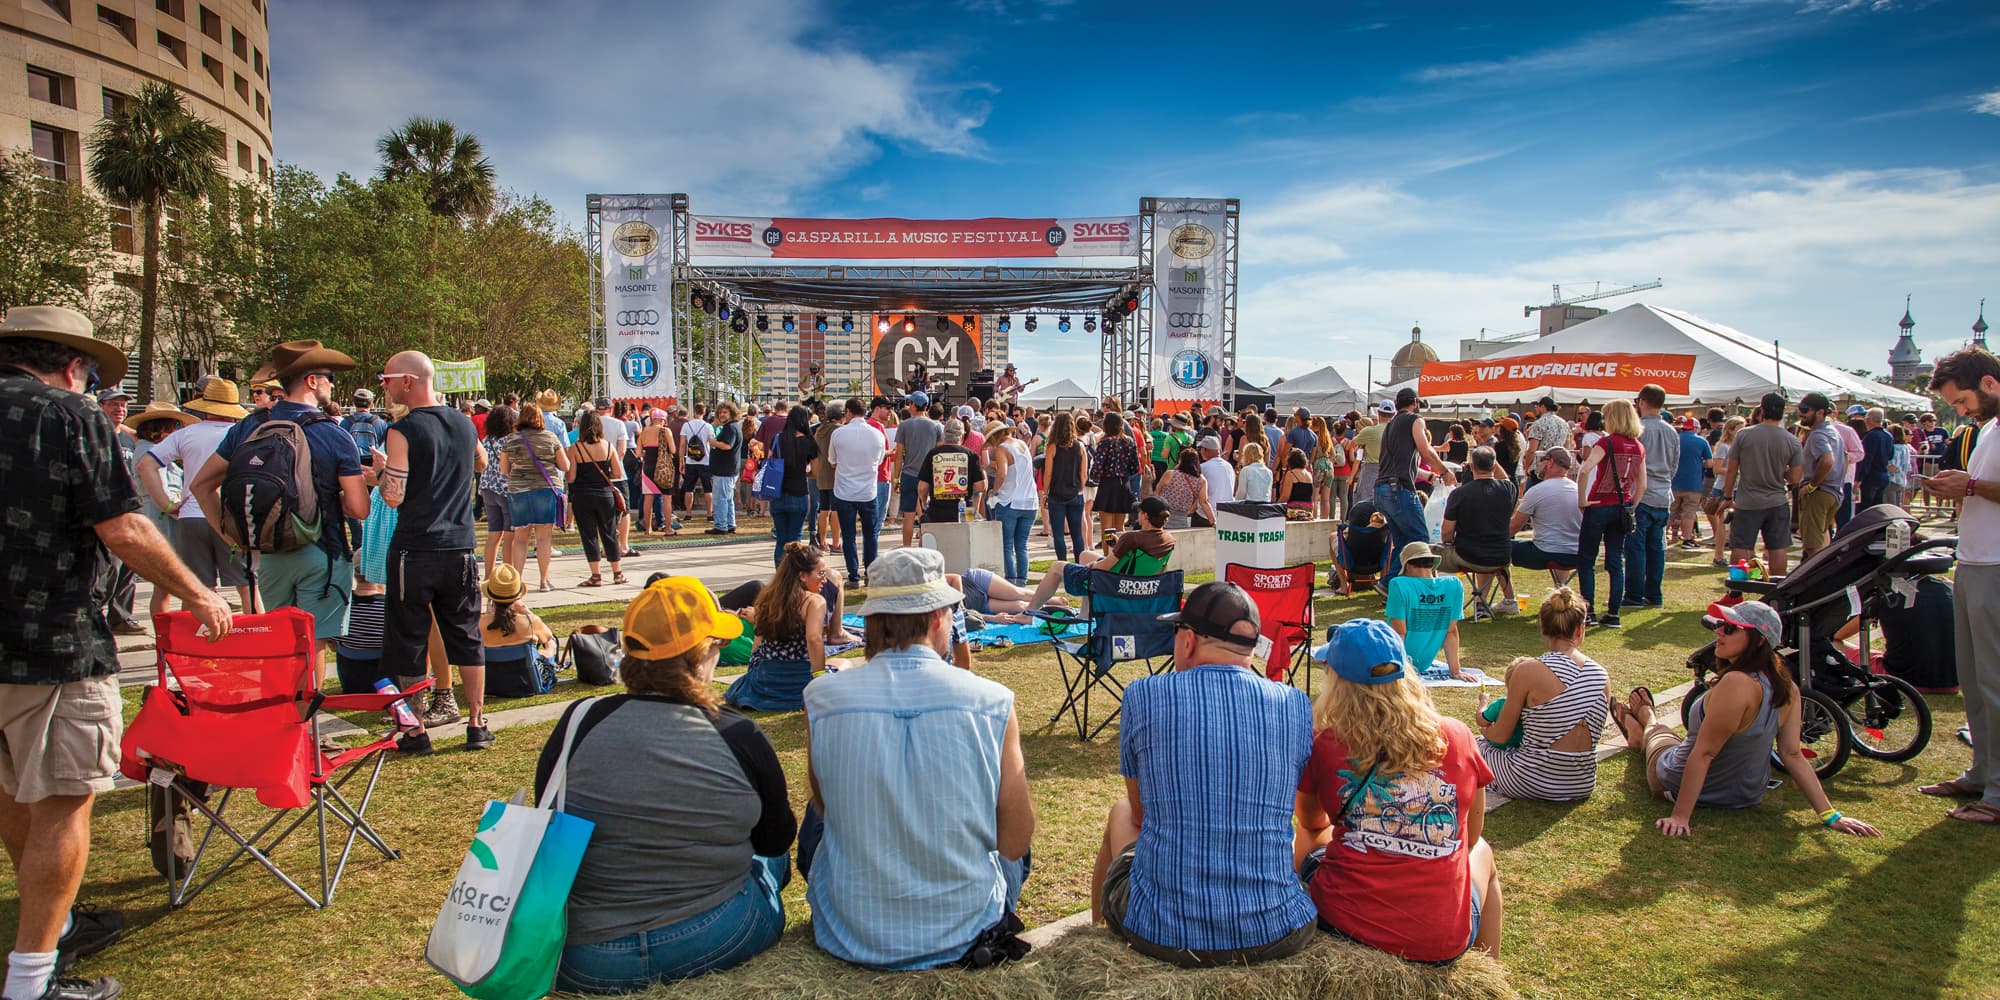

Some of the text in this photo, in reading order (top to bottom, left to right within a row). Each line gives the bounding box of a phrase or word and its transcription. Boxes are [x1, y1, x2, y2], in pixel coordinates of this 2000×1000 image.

[696, 222, 752, 237] SYKES
[1073, 222, 1130, 236] SYKES
[786, 231, 1042, 243] GASPARILLA MUSIC FESTIVAL
[615, 284, 657, 293] MASONITE
[1169, 287, 1212, 295] MASONITE
[626, 358, 654, 378] FL
[1176, 360, 1205, 379] FL
[1420, 362, 1688, 383] SYNOVUS VIP EXPERIENCE SYNOVUS
[437, 370, 483, 390] EXIT
[1218, 529, 1285, 543] TRASH TRASH
[1119, 579, 1160, 590] SPORTS
[1253, 581, 1291, 589] AUTHORITY
[1254, 573, 1292, 584] SPORTS
[1118, 588, 1157, 596] AUTHORITY
[1361, 834, 1440, 857] Key West
